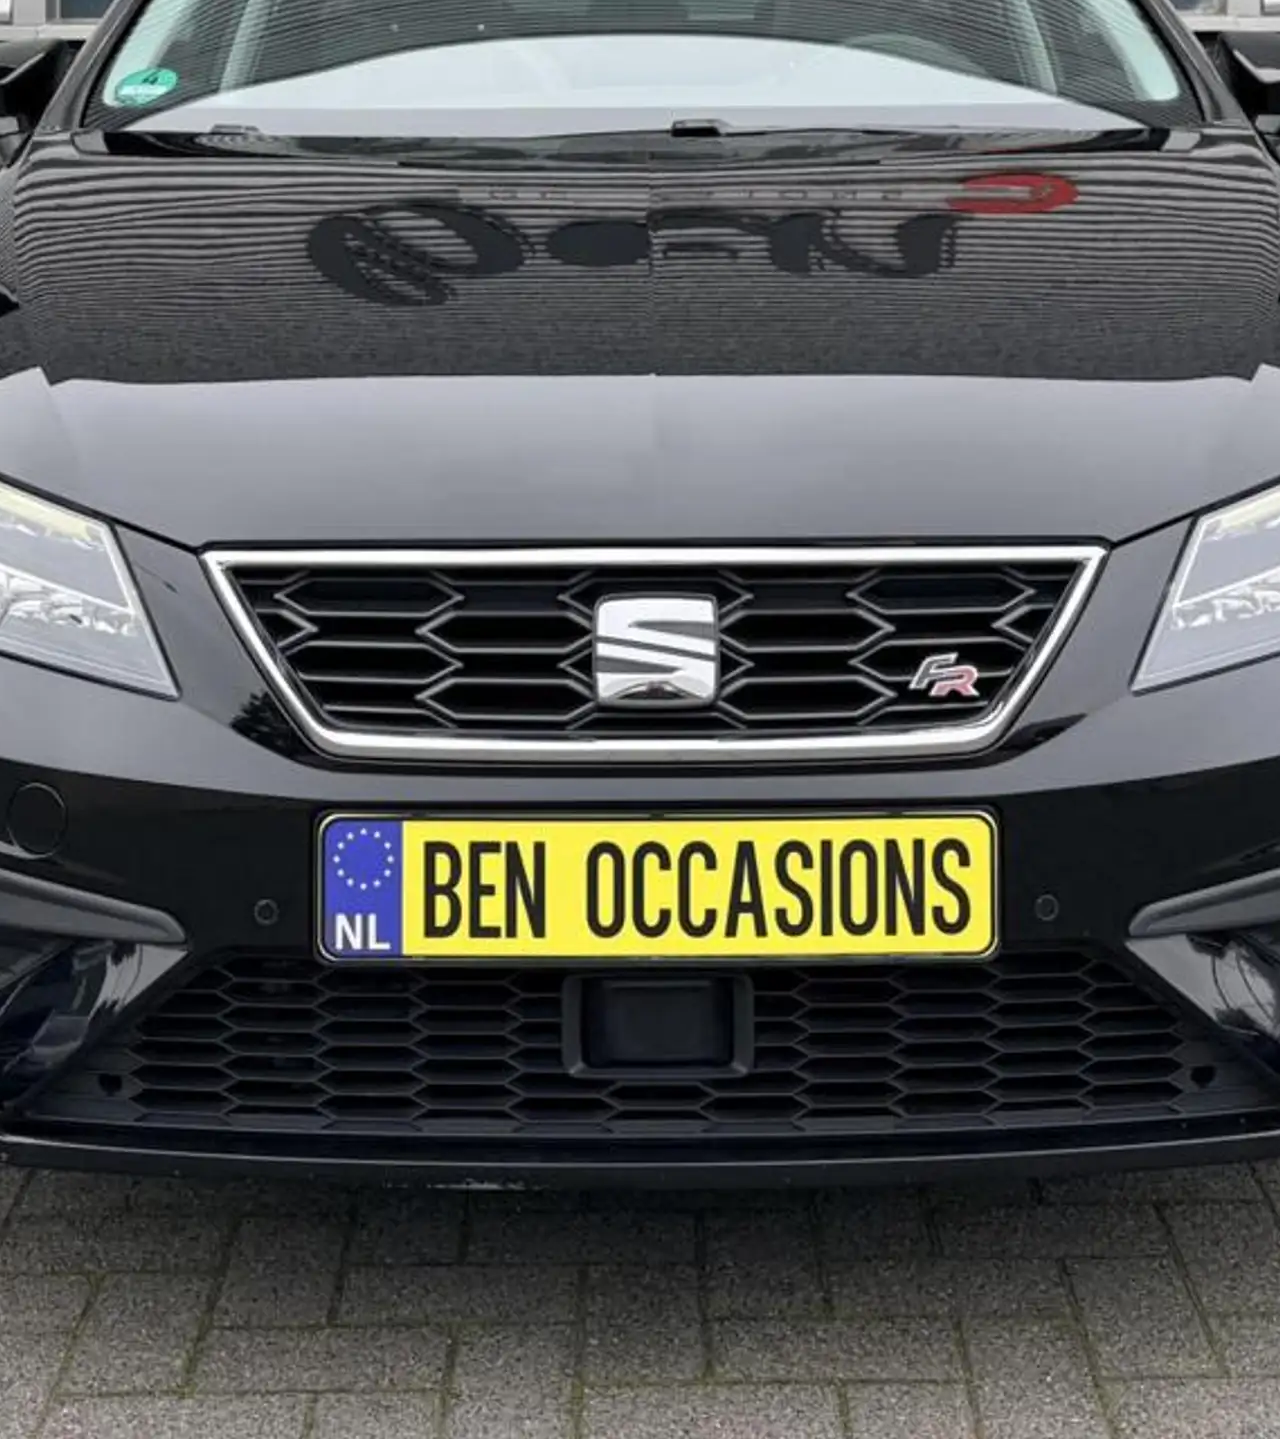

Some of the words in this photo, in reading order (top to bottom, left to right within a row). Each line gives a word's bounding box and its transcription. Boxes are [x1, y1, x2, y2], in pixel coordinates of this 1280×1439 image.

[908, 651, 980, 697] FR
[422, 840, 547, 939] BEN
[586, 838, 972, 939] OCCASIONS
[334, 912, 391, 950] NL
